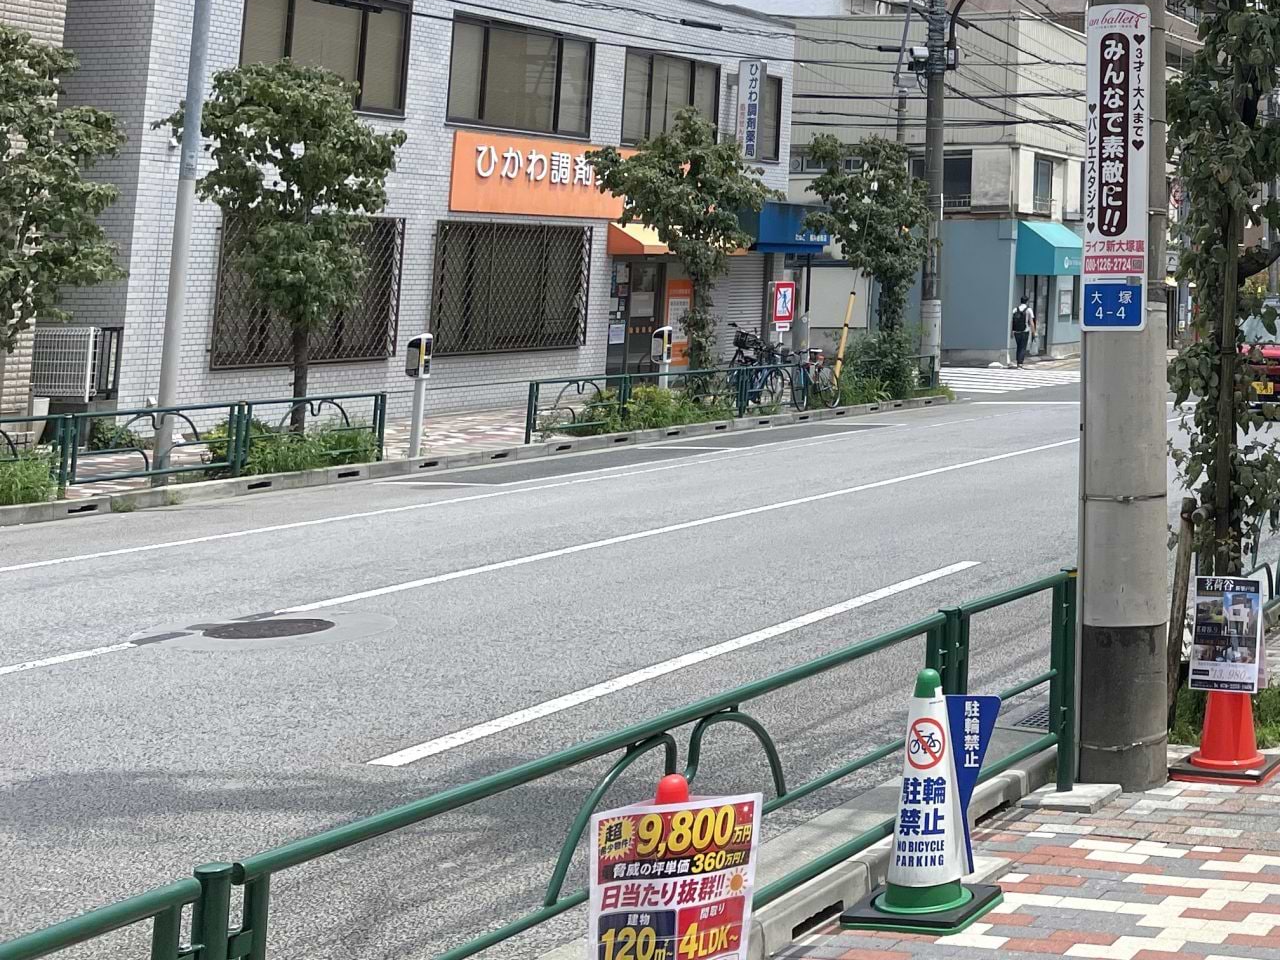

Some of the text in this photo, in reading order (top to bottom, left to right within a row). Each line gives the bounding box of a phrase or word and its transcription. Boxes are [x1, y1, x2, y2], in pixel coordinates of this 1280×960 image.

[745, 64, 759, 157] ひかわ調剤薬局
[1102, 40, 1125, 233] みんなで素敵に!!
[476, 144, 611, 186] ひかわ調剤
[1087, 116, 1097, 218] バレエスタジオ
[1085, 240, 1145, 253] ライフ新大塚裏
[1091, 290, 1132, 304] 大塚
[1095, 306, 1126, 320] 4-4
[964, 701, 980, 768] 駐輪禁止
[903, 777, 947, 805] 駐輪
[899, 808, 945, 836] 禁止
[896, 840, 945, 853] NO BICYCLE
[896, 854, 944, 867] PARKING
[627, 913, 650, 927] 建物
[700, 902, 725, 920] 間取り
